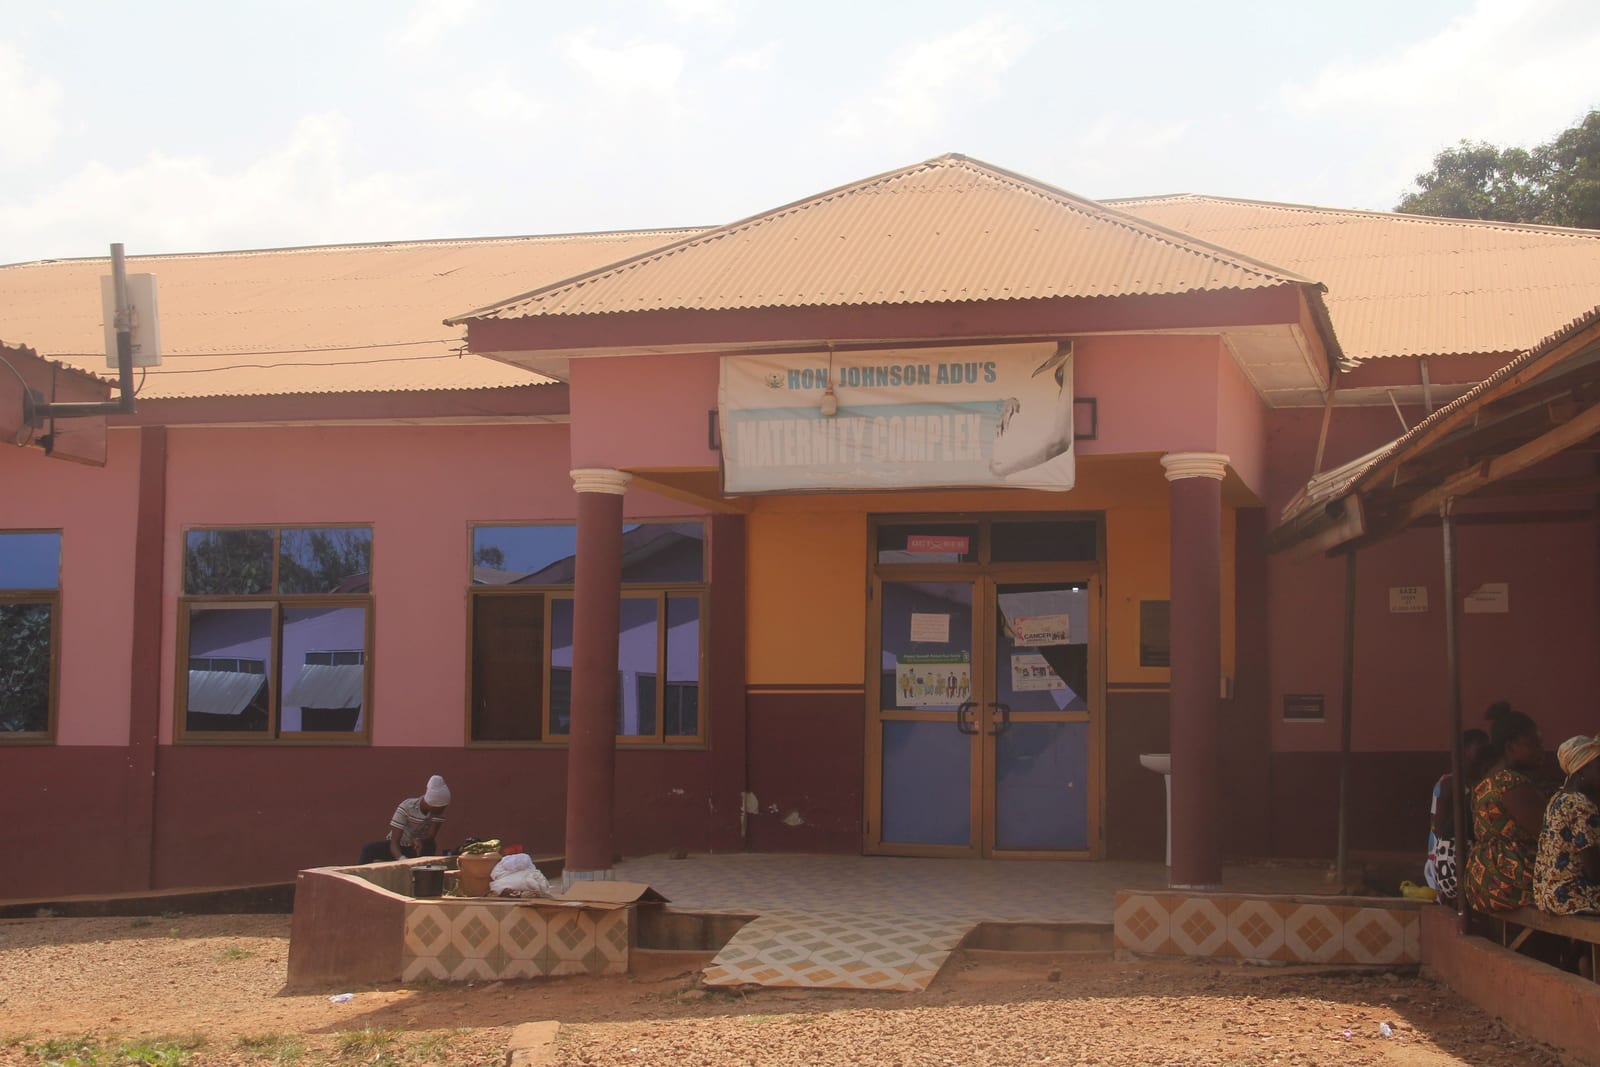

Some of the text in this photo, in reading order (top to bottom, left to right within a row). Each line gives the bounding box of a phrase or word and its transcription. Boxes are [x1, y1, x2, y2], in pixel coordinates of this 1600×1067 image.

[838, 364, 930, 387] JOHNSON
[935, 361, 997, 384] ADU'S
[737, 414, 982, 466] MATERNITY COMPLEX
